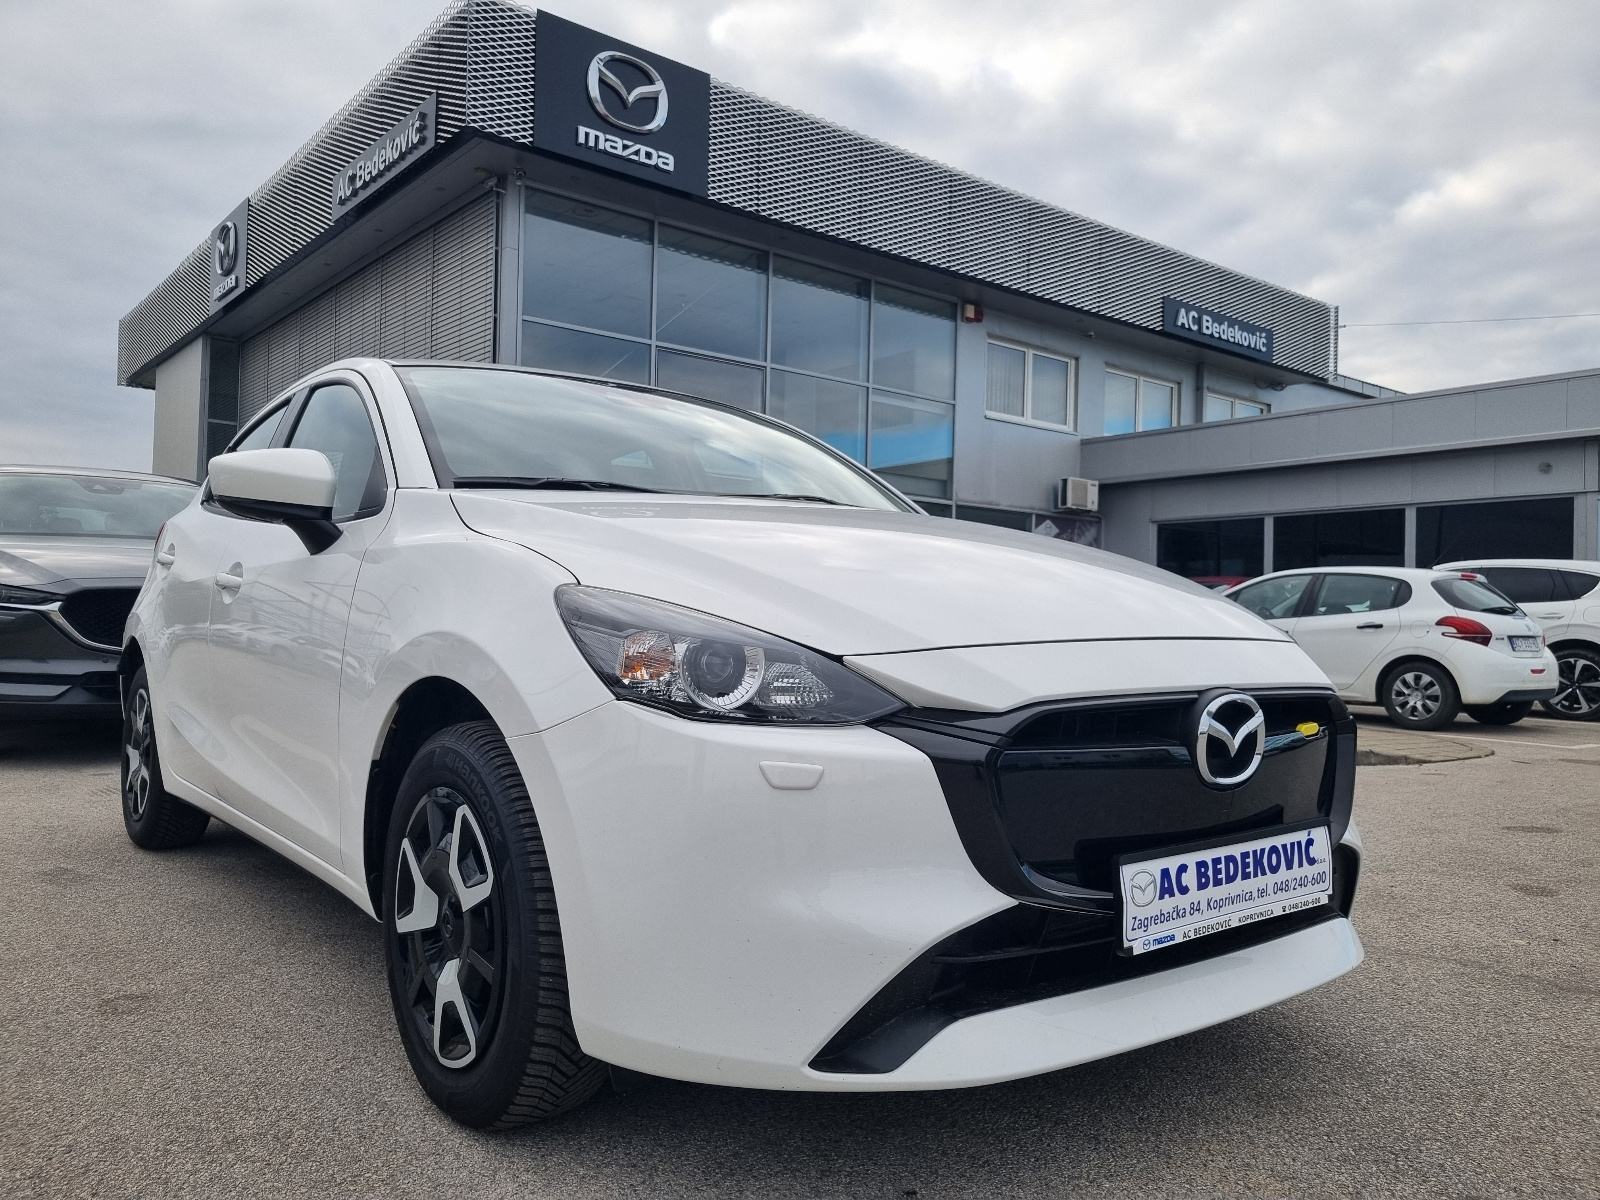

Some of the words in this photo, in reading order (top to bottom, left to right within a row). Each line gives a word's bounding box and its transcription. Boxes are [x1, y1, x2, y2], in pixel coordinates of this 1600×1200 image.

[336, 169, 353, 204] AC
[356, 111, 420, 189] Bedeković
[577, 125, 675, 172] mazda
[1177, 307, 1199, 331] AC
[1202, 314, 1267, 352] Bedeković
[1158, 863, 1190, 901] AC
[1195, 830, 1317, 892] BEDEKOVIĆ
[1131, 906, 1187, 933] Zagrebačka
[1189, 902, 1204, 919] 84,
[1206, 888, 1256, 914] Koprivnica,
[1257, 882, 1271, 898] tel.
[1273, 870, 1327, 895] 048/240-600
[1182, 929, 1192, 940] AC
[1193, 917, 1232, 938] BEDEKOVIĆ
[1238, 908, 1274, 924] KOPRIVNICA
